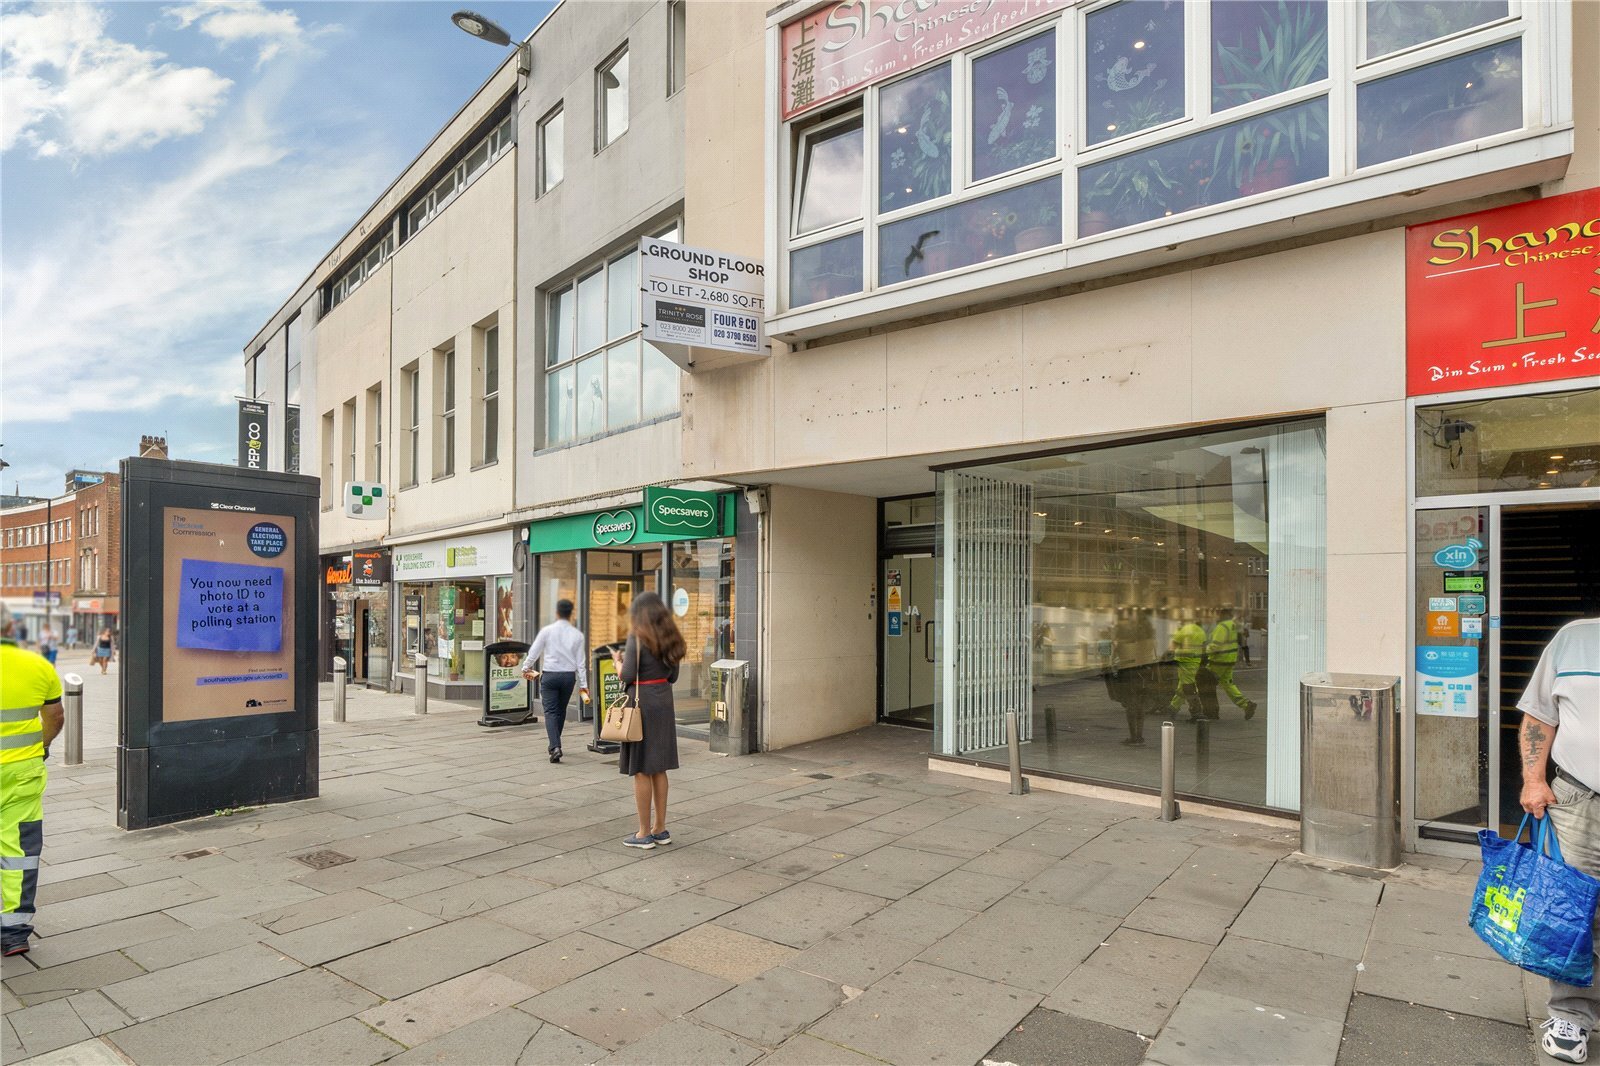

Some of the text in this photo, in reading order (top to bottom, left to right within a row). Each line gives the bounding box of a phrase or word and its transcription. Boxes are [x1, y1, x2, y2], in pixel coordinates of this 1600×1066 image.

[861, 59, 896, 80] Sum
[911, 33, 953, 59] Fresh
[649, 244, 764, 276] GROUND FLOOR
[1504, 245, 1594, 267] Chinese
[688, 267, 729, 284] SHOP
[649, 280, 668, 292] TO
[672, 284, 693, 297] LET
[658, 308, 685, 318] TRINITY
[685, 311, 703, 321] ROSE
[714, 313, 737, 327] FOUR
[738, 317, 744, 328] &
[745, 318, 757, 330] CO
[672, 324, 686, 332] 8000
[688, 326, 702, 334] 2020
[714, 329, 725, 338] 020
[742, 332, 757, 342] 8500
[1428, 365, 1463, 382] Dim
[1467, 360, 1505, 375] Sum
[1521, 352, 1566, 368] Fresh
[234, 504, 256, 512] Channel
[658, 505, 709, 518] Specsavers
[172, 528, 217, 537] Commission
[595, 521, 631, 535] Specsavers
[419, 561, 435, 569] SOCIETY
[190, 576, 272, 589] You now need
[200, 588, 265, 605] photo ID to
[208, 604, 233, 613] vote
[237, 603, 249, 612] at
[191, 614, 276, 632] polling station
[491, 668, 514, 678] FREE
